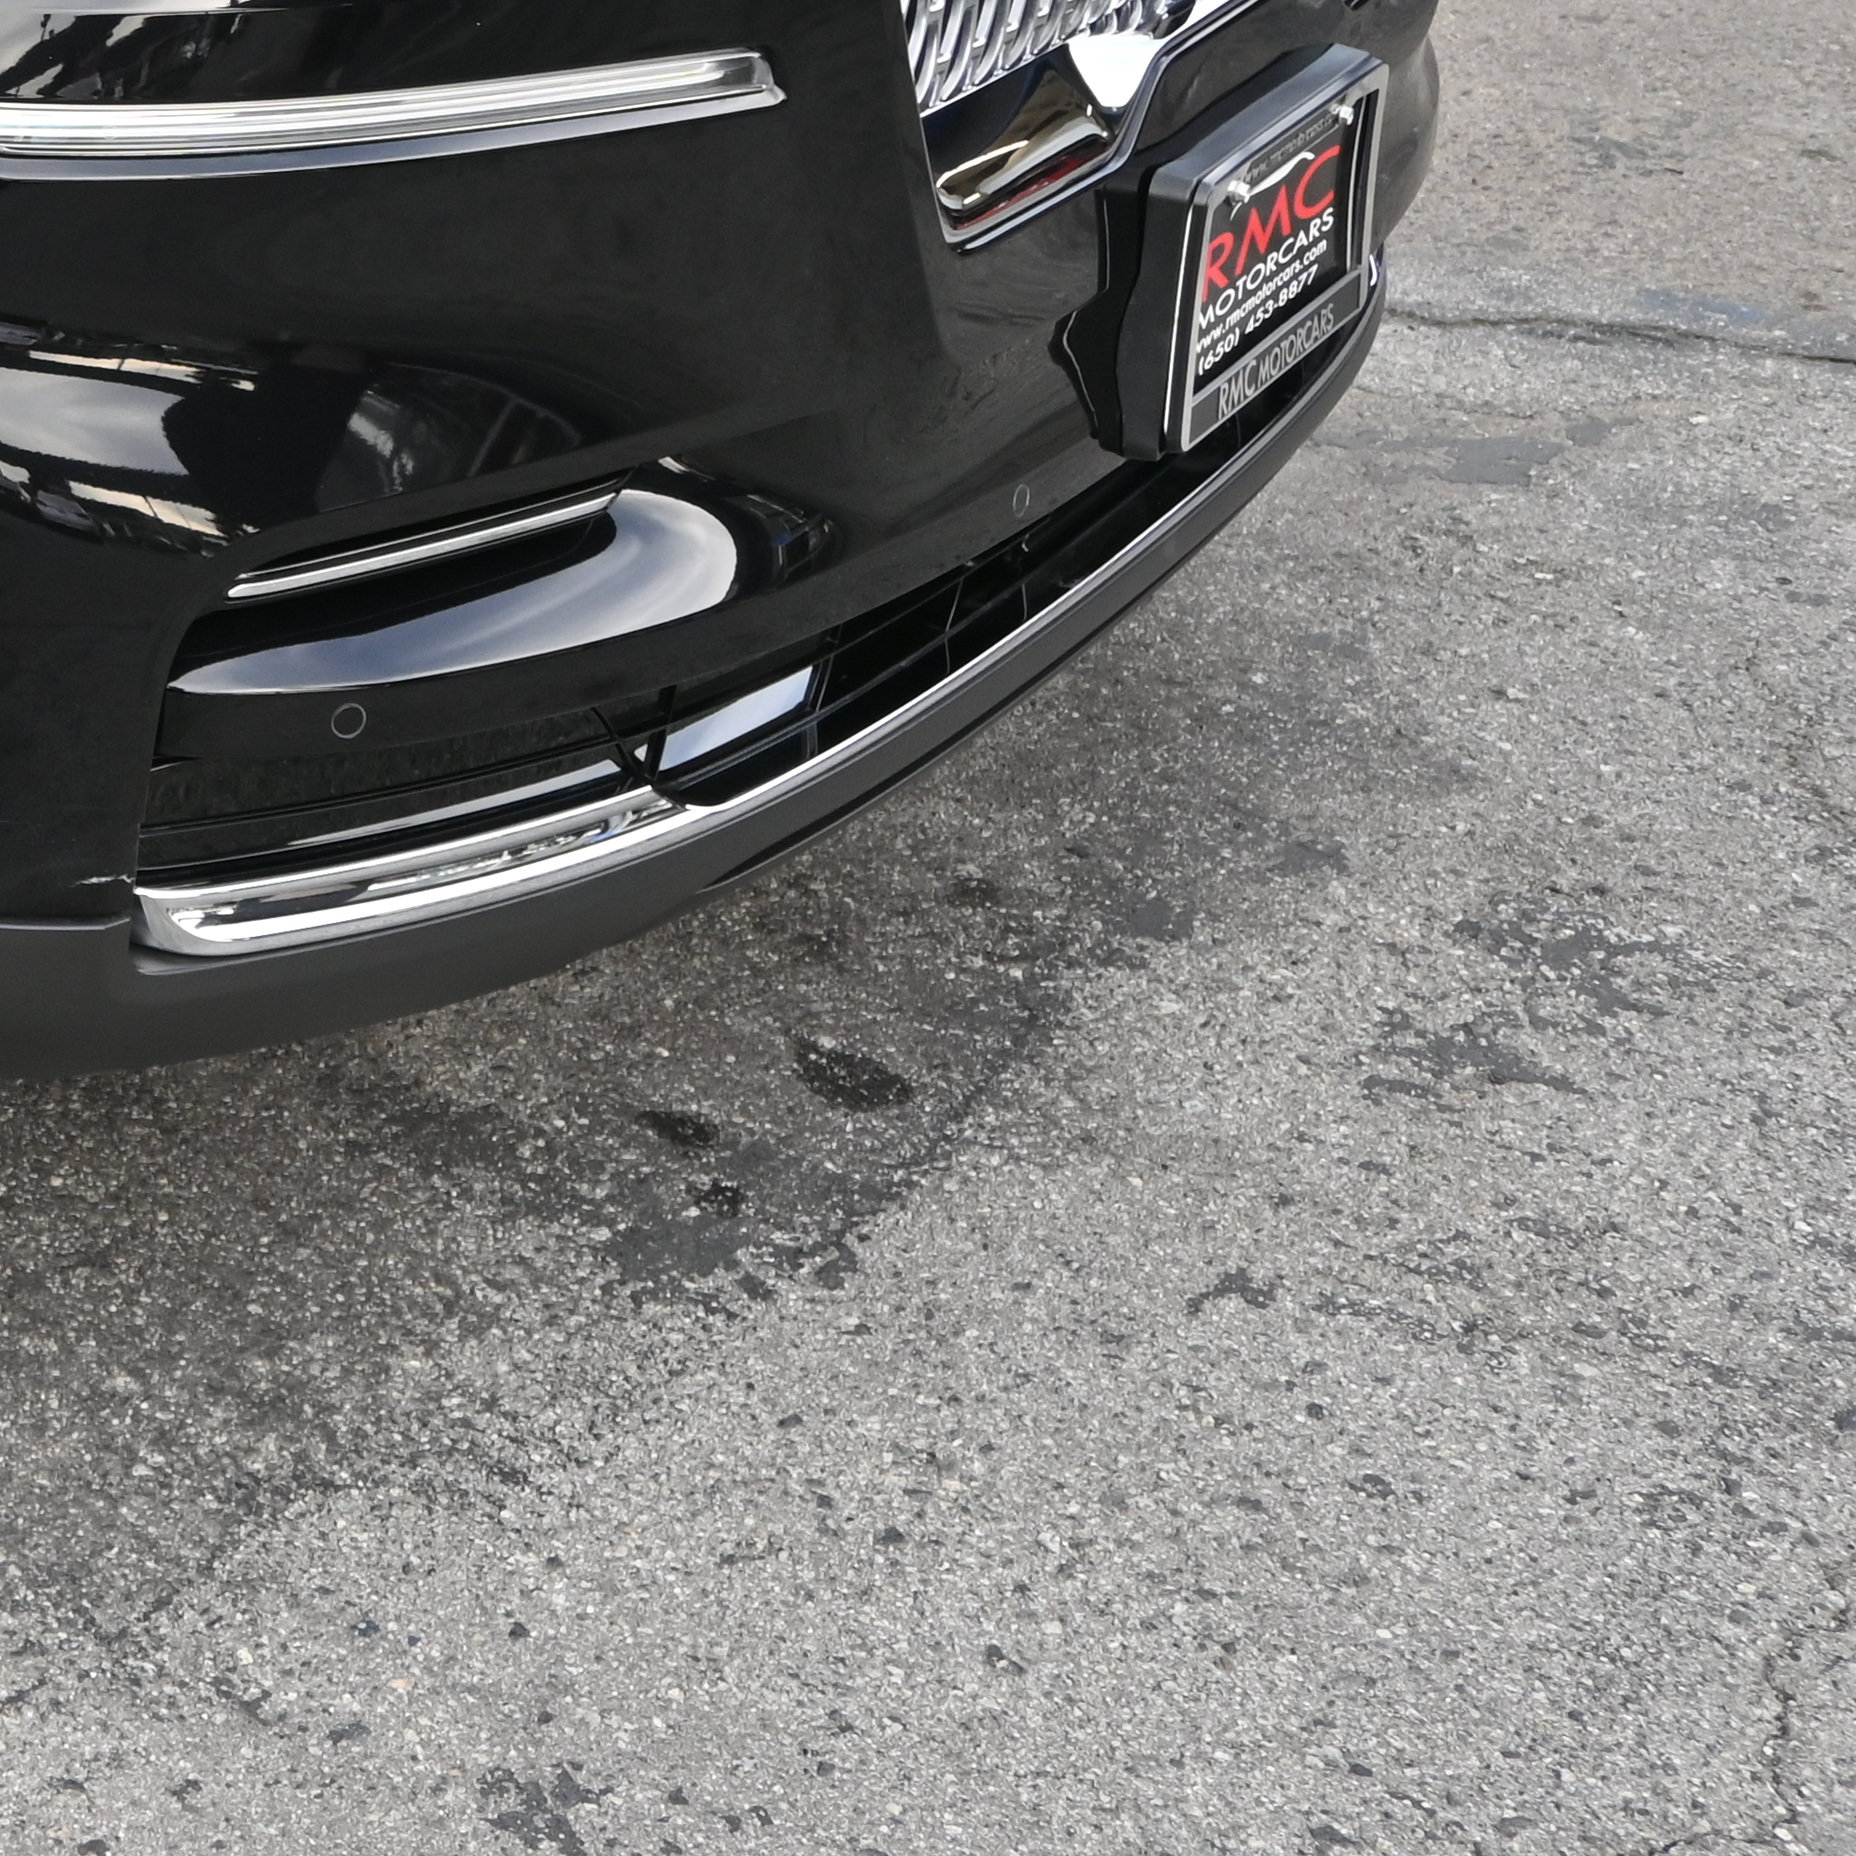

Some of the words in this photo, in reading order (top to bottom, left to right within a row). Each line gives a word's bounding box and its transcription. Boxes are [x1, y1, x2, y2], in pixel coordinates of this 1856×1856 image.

[1198, 207, 1334, 330] MOTORCARS
[1202, 145, 1341, 303] RMC
[1198, 327, 1240, 376] (650)
[1245, 264, 1318, 334] 453-8877
[1218, 359, 1257, 421] RMC
[1257, 303, 1335, 388] MOTORCARS
